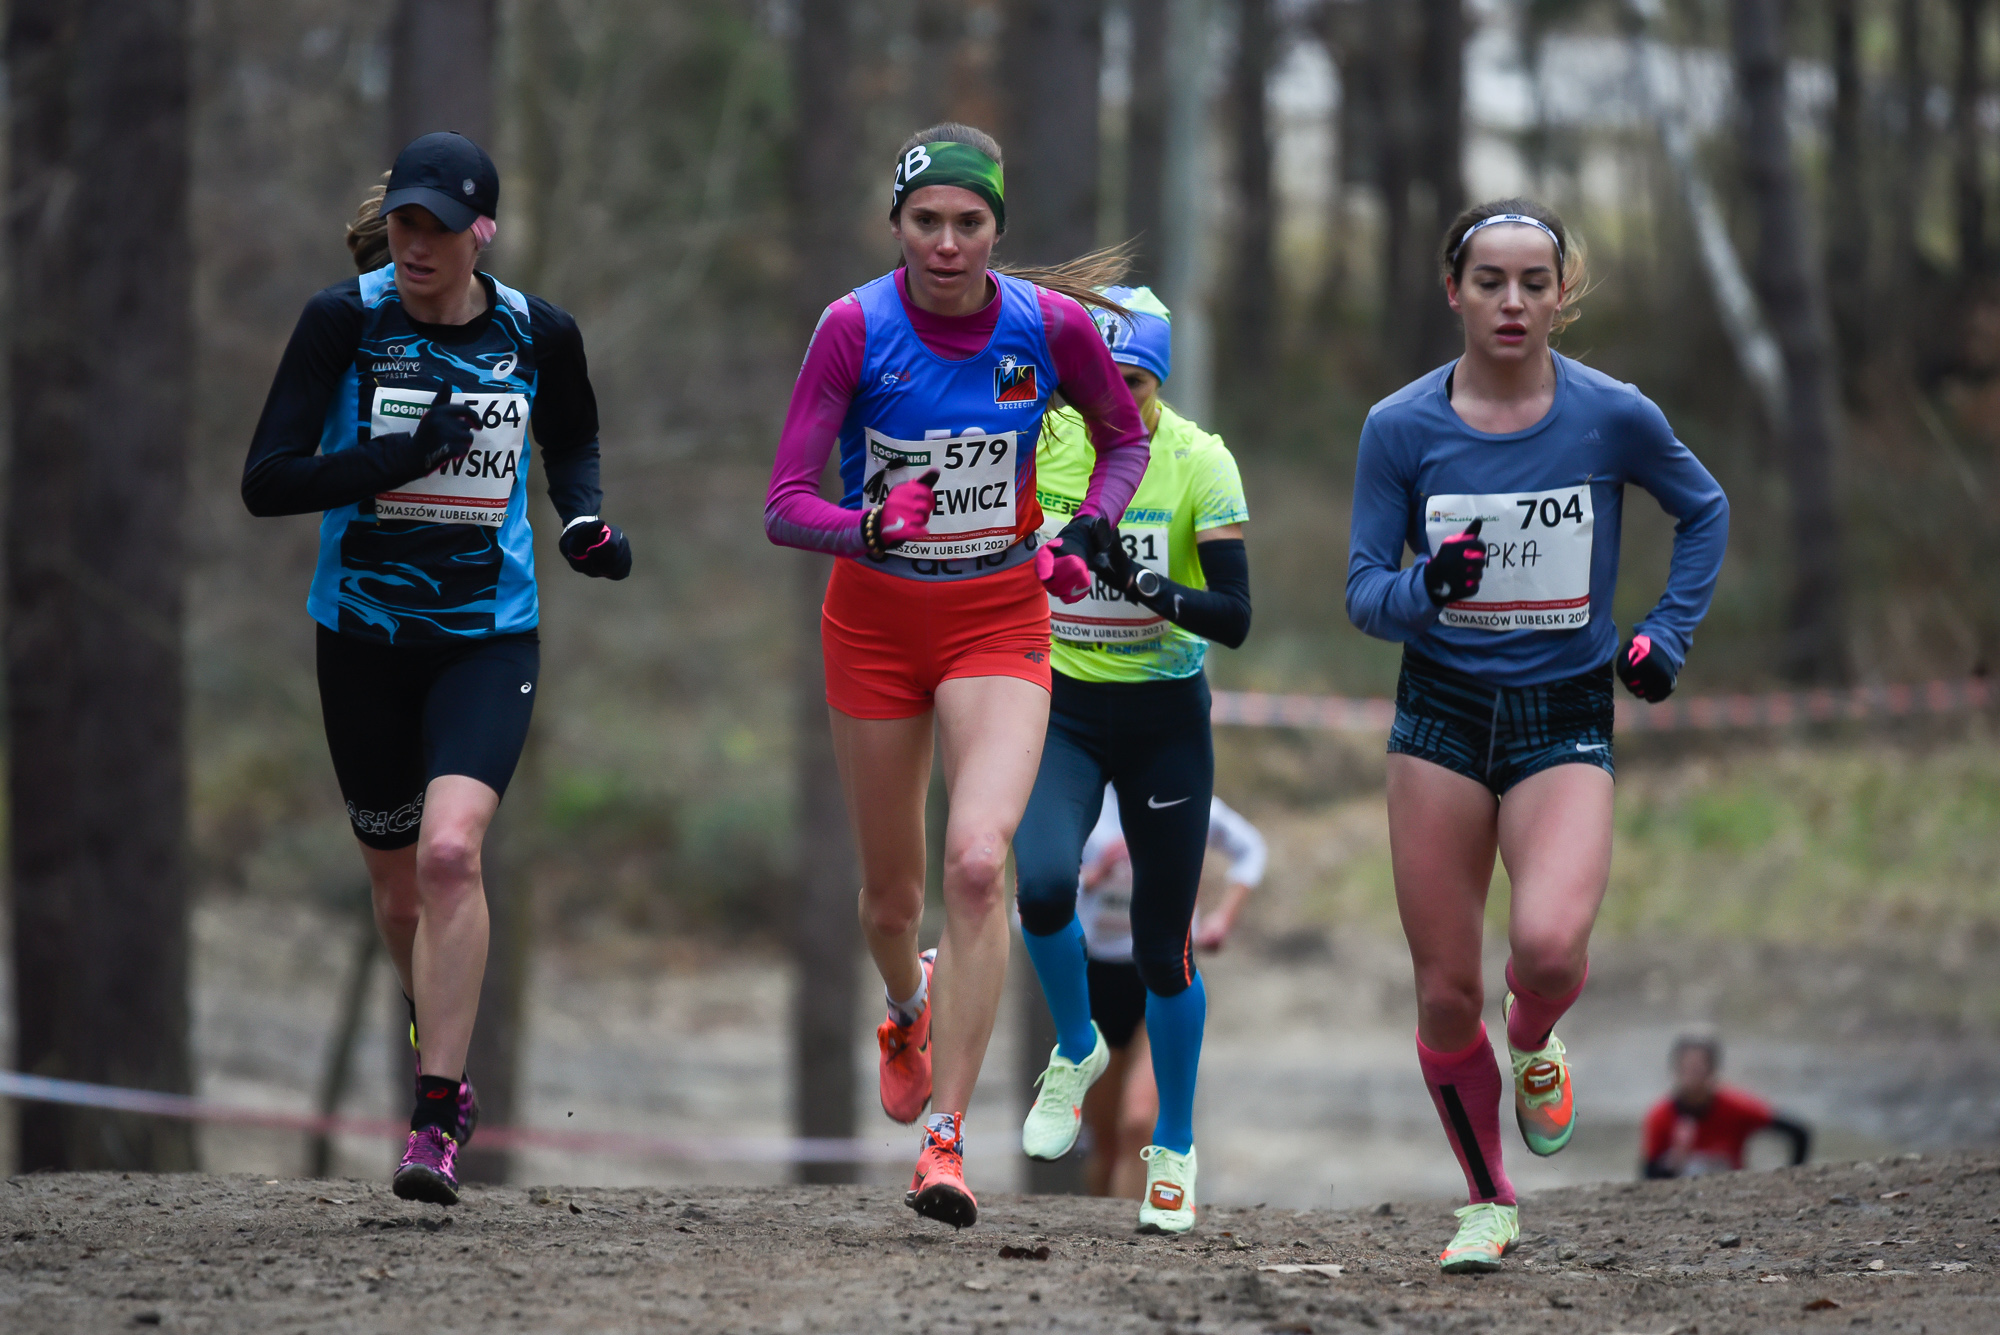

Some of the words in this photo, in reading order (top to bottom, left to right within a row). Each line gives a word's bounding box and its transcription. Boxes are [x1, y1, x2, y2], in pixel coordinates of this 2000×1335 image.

[372, 360, 421, 372] amore
[463, 399, 521, 429] 64
[998, 402, 1035, 410] SZCZECIN
[944, 439, 1008, 470] 579
[438, 449, 517, 479] WSKA
[376, 504, 437, 518] OMASZÓW
[439, 510, 488, 521] LUBELSKI
[490, 512, 505, 522] 20
[1516, 494, 1583, 530] 704
[898, 543, 931, 555] SZÓW
[934, 542, 981, 555] LUBELSKI
[984, 539, 1009, 550] 2021
[1121, 533, 1159, 560] 31
[1485, 540, 1542, 569] PKA
[1445, 612, 1511, 626] TOMASZÓW
[1514, 614, 1565, 625] LUBELSKI
[1093, 629, 1138, 638] LUBELSKI
[1141, 624, 1164, 636] 2021
[1024, 650, 1045, 664] 4F
